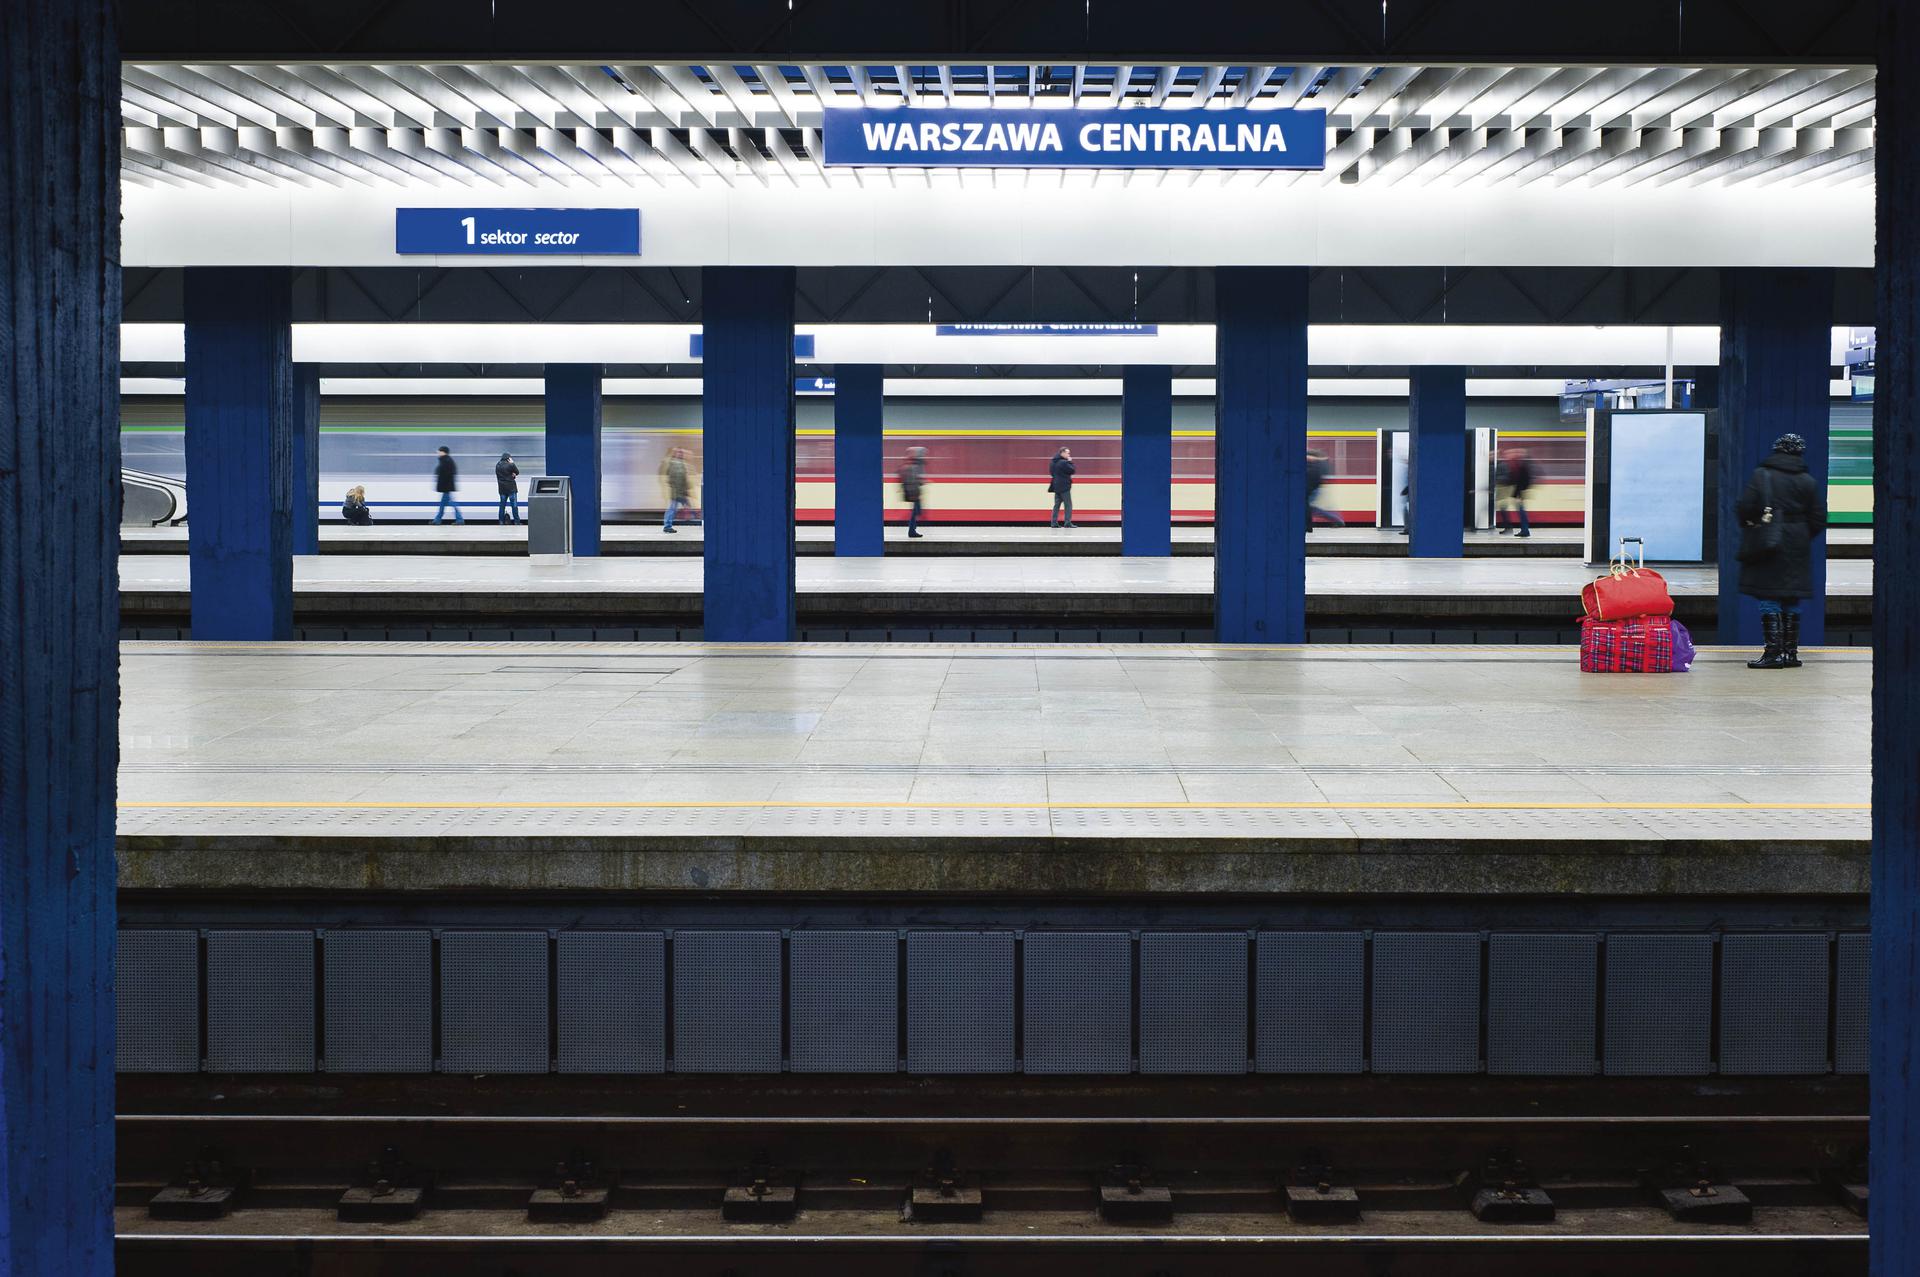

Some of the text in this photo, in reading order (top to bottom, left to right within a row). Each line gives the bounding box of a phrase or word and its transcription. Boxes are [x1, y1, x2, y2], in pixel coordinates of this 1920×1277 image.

[862, 122, 1288, 152] WARSZAWA CENTRALNA
[461, 216, 580, 245] 1 sektor sector
[814, 377, 824, 389] 4
